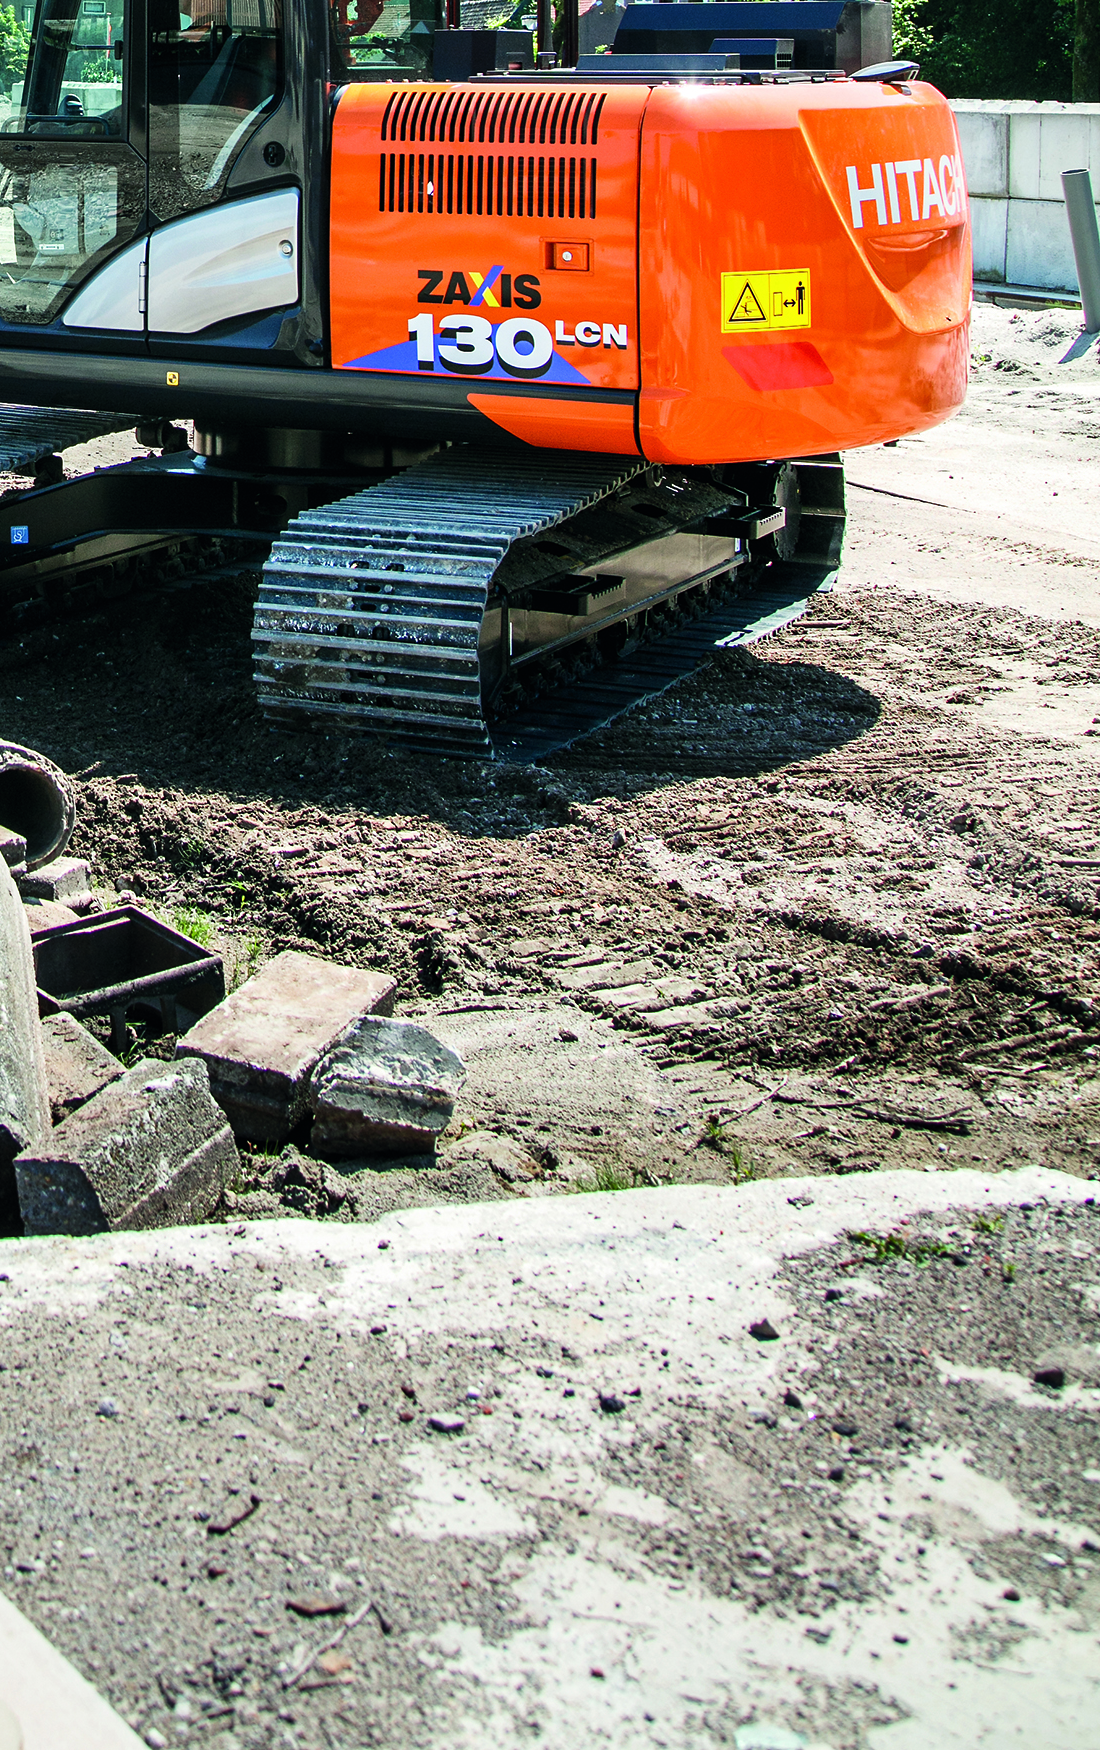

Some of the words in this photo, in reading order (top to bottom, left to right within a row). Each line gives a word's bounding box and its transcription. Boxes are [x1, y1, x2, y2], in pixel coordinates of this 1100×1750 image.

[845, 154, 967, 229] HITACH
[417, 265, 542, 310] ZAXIS
[407, 312, 554, 379] 130
[555, 319, 628, 350] LCN
